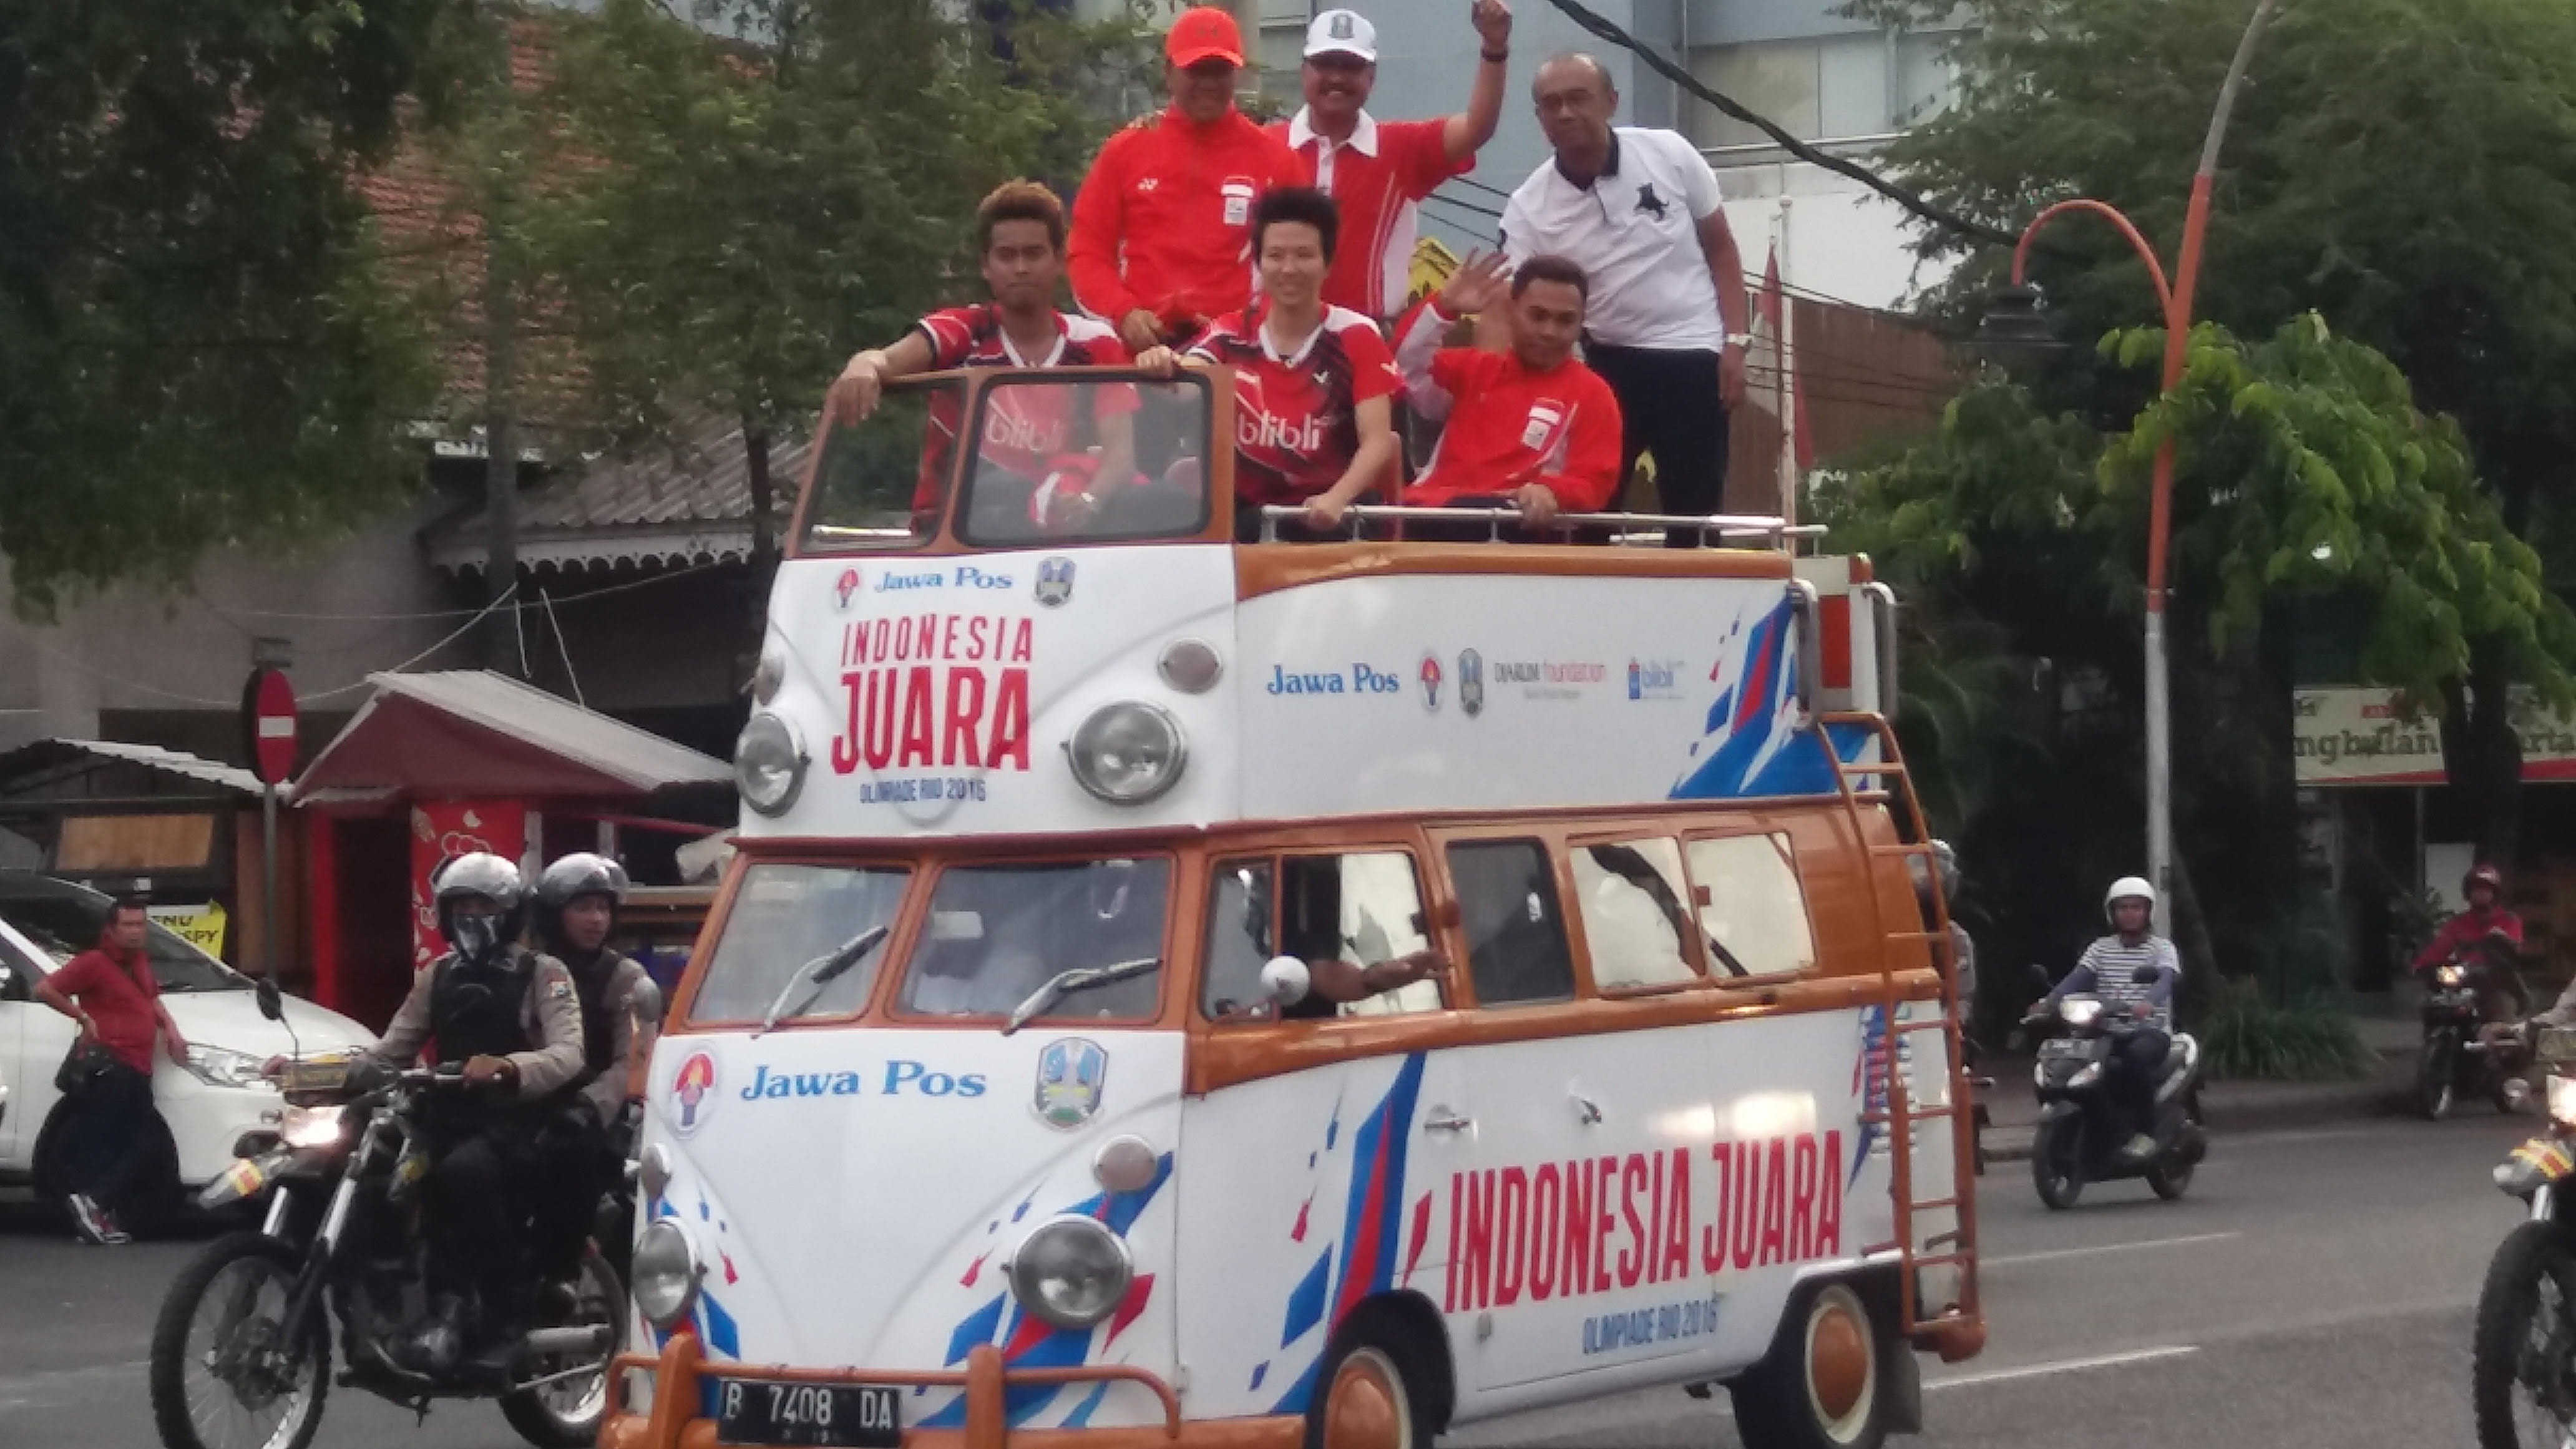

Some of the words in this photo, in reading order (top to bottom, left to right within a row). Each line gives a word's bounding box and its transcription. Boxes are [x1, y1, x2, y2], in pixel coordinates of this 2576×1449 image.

[1237, 409, 1321, 451] blibli
[875, 570, 944, 592] Jawa
[954, 566, 1013, 590] Pos
[841, 613, 1033, 666] INDONESIA
[1267, 665, 1344, 695] Jawa
[1351, 659, 1400, 693] Pos
[831, 666, 1031, 775] JUARA
[947, 776, 986, 802] 2016
[740, 1065, 861, 1101] Jawa
[881, 1059, 987, 1097] Pos
[1443, 1147, 1690, 1314] INDONESIA
[1702, 1129, 1842, 1275] JUARA
[1682, 1298, 1720, 1337] 2016
[724, 1382, 742, 1420] B
[768, 1384, 832, 1425] 7408
[859, 1390, 892, 1430] DA
